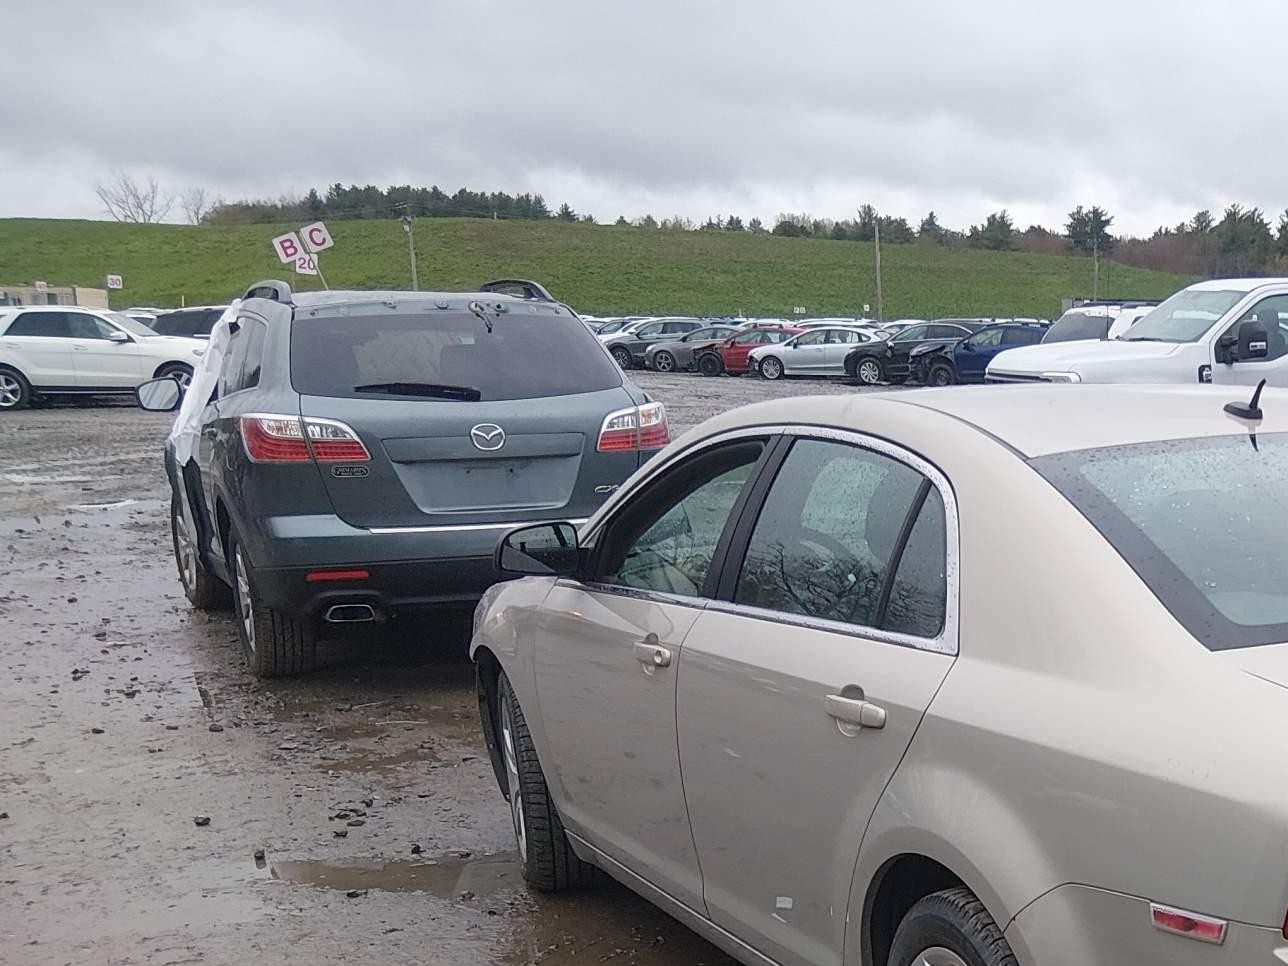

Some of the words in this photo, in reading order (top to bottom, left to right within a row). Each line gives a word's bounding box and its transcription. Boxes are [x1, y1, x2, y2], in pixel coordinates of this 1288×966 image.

[309, 228, 326, 246] C
[279, 238, 298, 258] B
[298, 257, 316, 270] 20
[109, 278, 120, 287] 30
